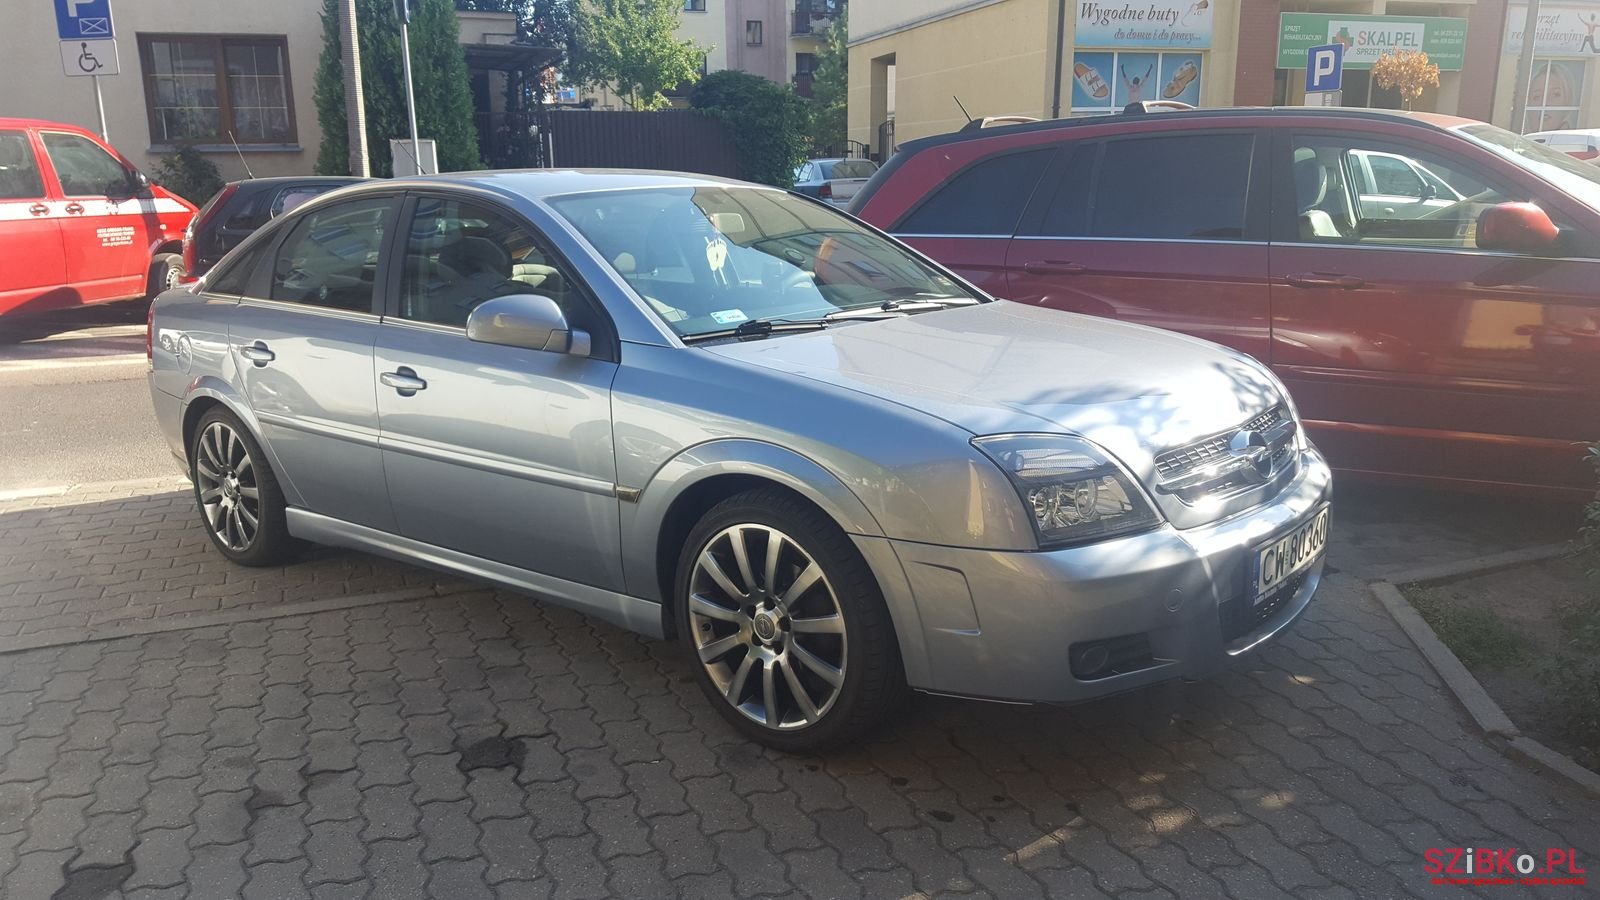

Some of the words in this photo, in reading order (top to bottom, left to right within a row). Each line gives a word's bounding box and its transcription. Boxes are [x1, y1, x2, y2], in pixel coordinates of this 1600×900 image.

[1081, 2, 1145, 26] Wygodne
[1147, 4, 1179, 27] buty
[1538, 14, 1560, 27] rzęt
[1114, 27, 1126, 40] do
[1158, 28, 1169, 40] do
[1358, 31, 1418, 46] SKALPEL
[1313, 50, 1335, 86] P
[1263, 541, 1287, 586] CW
[1290, 512, 1327, 569] 80360
